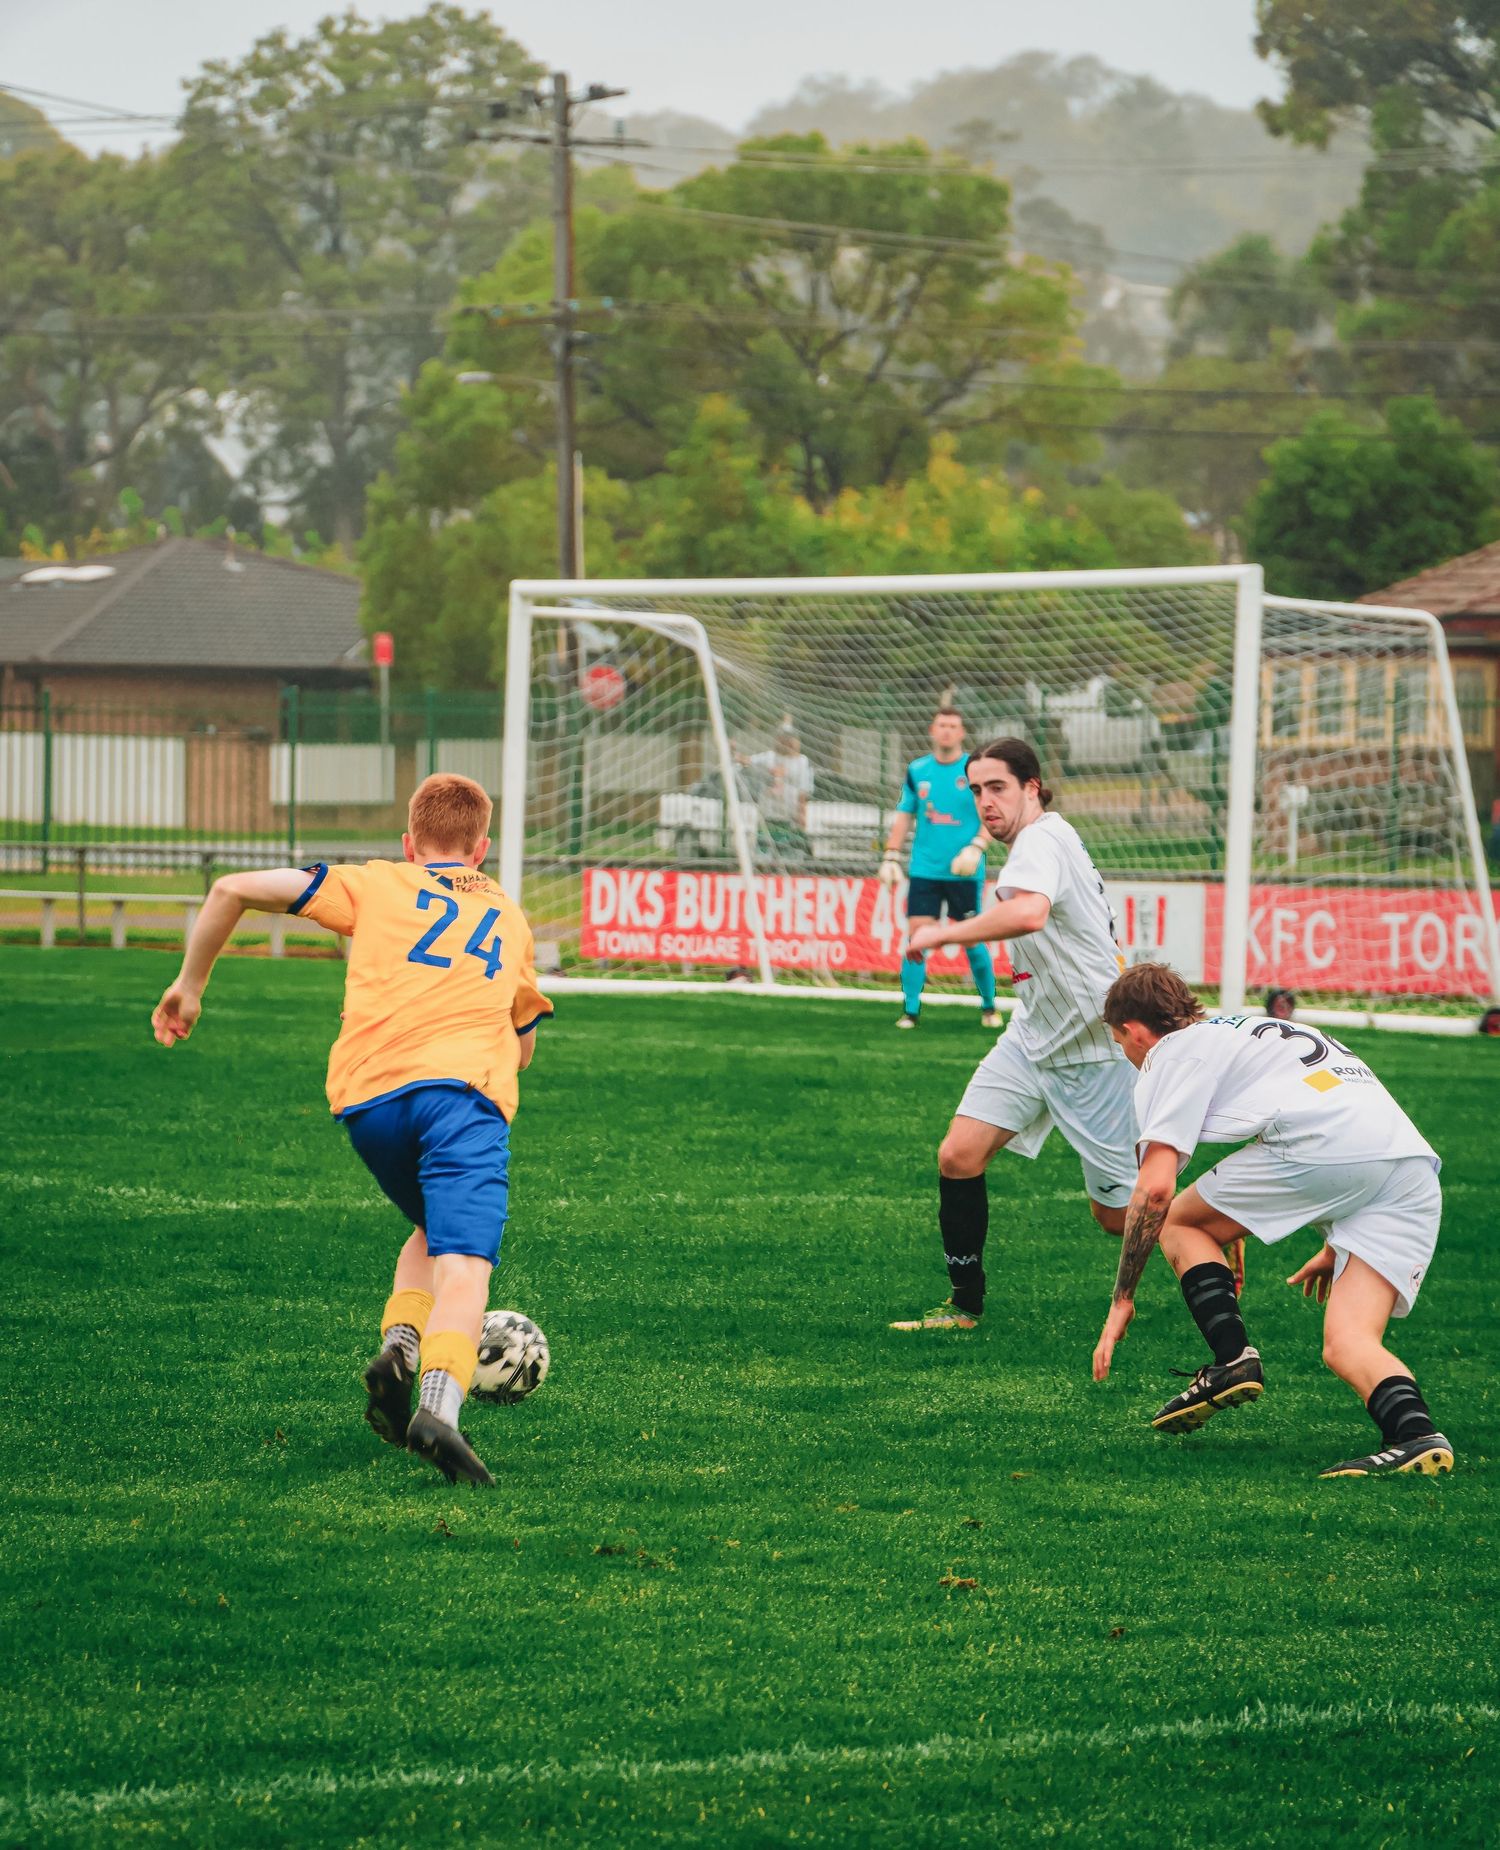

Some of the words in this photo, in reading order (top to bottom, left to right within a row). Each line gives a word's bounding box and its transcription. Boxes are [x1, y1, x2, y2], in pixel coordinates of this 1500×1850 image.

[408, 888, 502, 980] 24
[591, 869, 665, 928] DKS
[675, 873, 864, 936] BUTCHERY
[596, 930, 656, 957] TOWN
[661, 932, 741, 961] SQUARE
[748, 937, 847, 965] TRONTO
[1247, 905, 1336, 969] KFC
[1380, 911, 1500, 972] TOR
